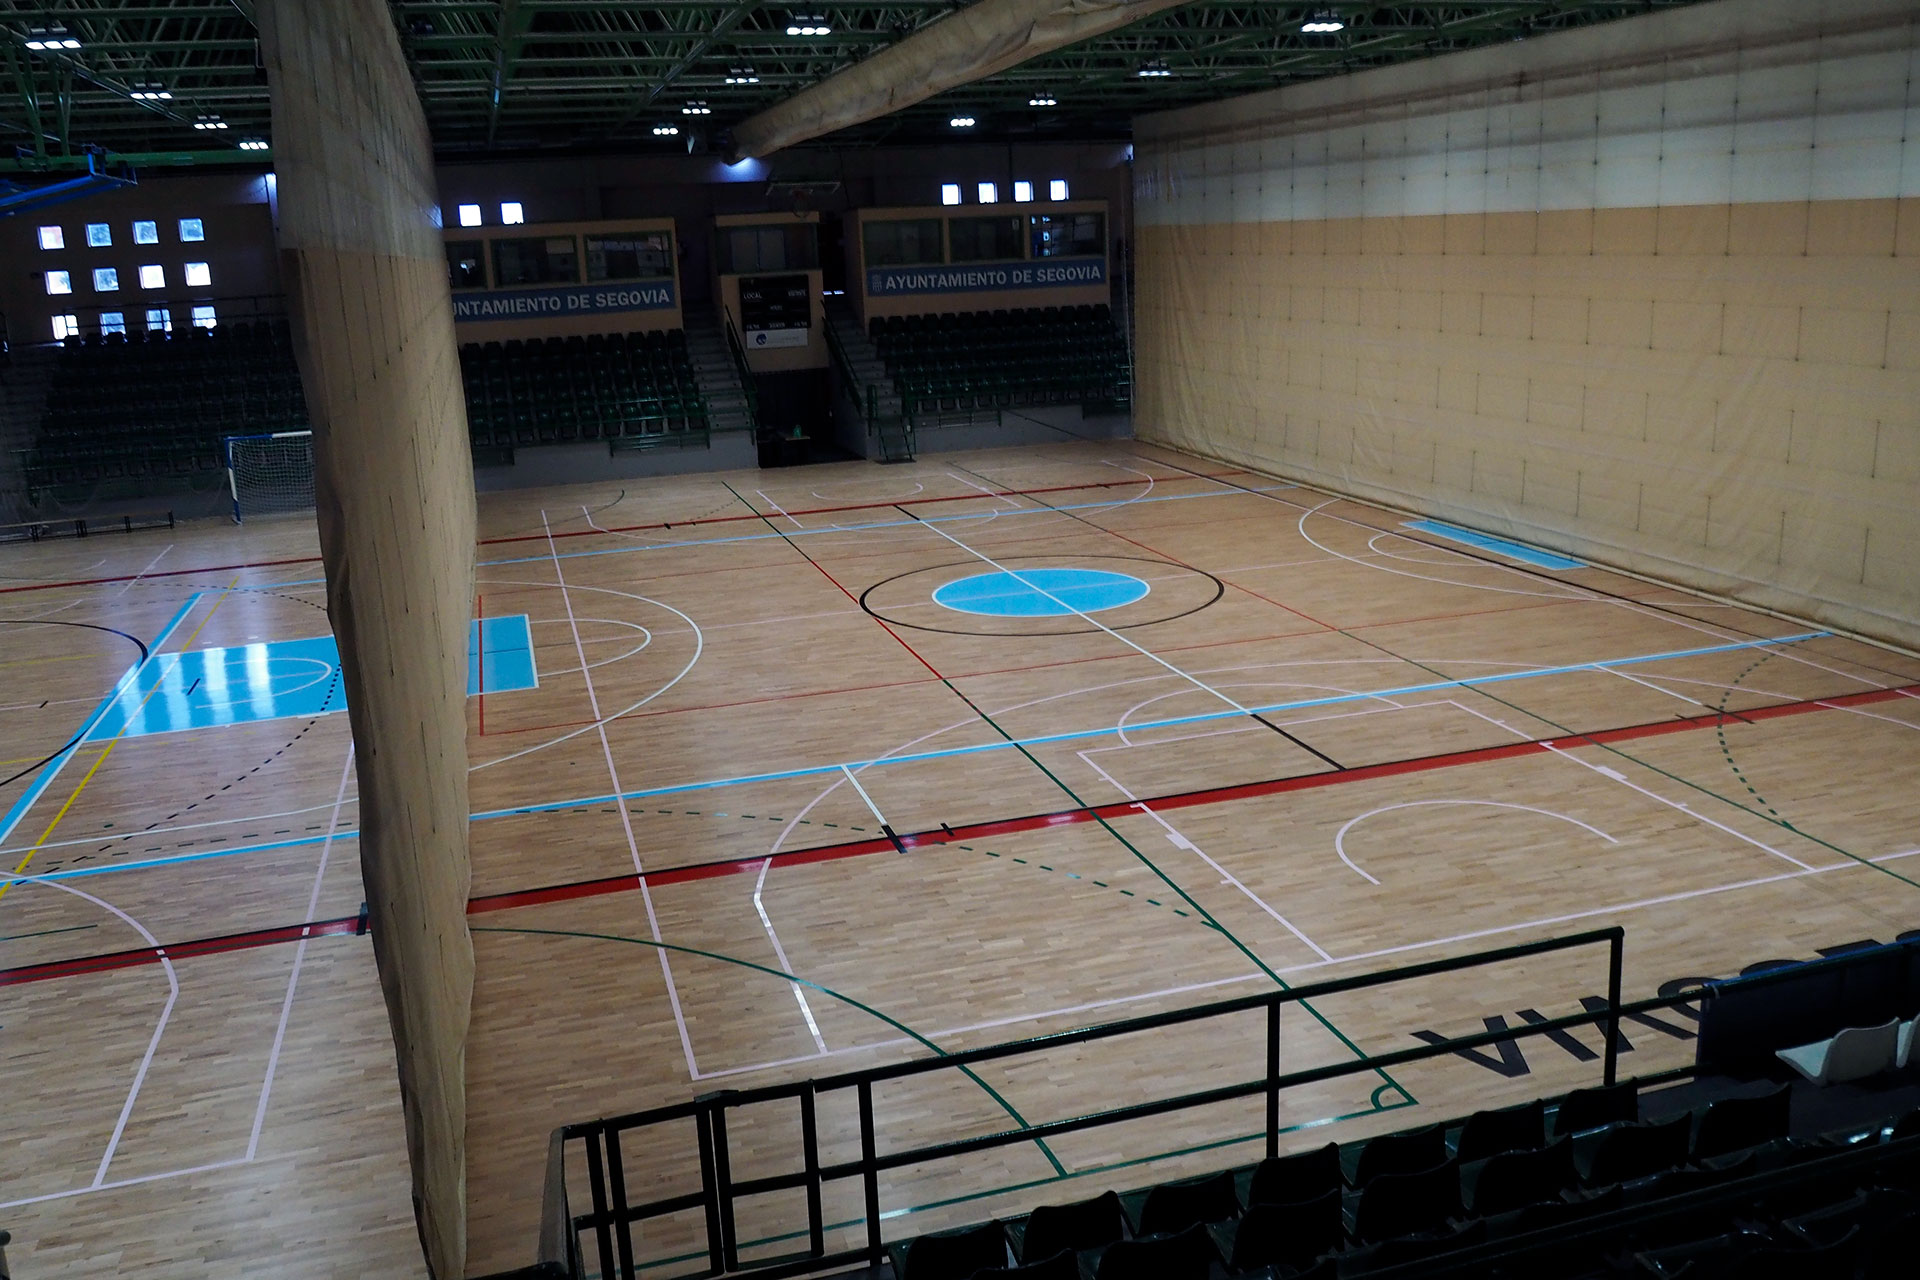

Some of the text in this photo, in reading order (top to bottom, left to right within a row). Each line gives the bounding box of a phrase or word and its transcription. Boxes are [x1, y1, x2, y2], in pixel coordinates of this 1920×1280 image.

[885, 265, 1101, 290] AYUNTAMIENTO DE SEGOVIA
[567, 294, 591, 310] DE
[595, 288, 670, 308] SEGOVIA
